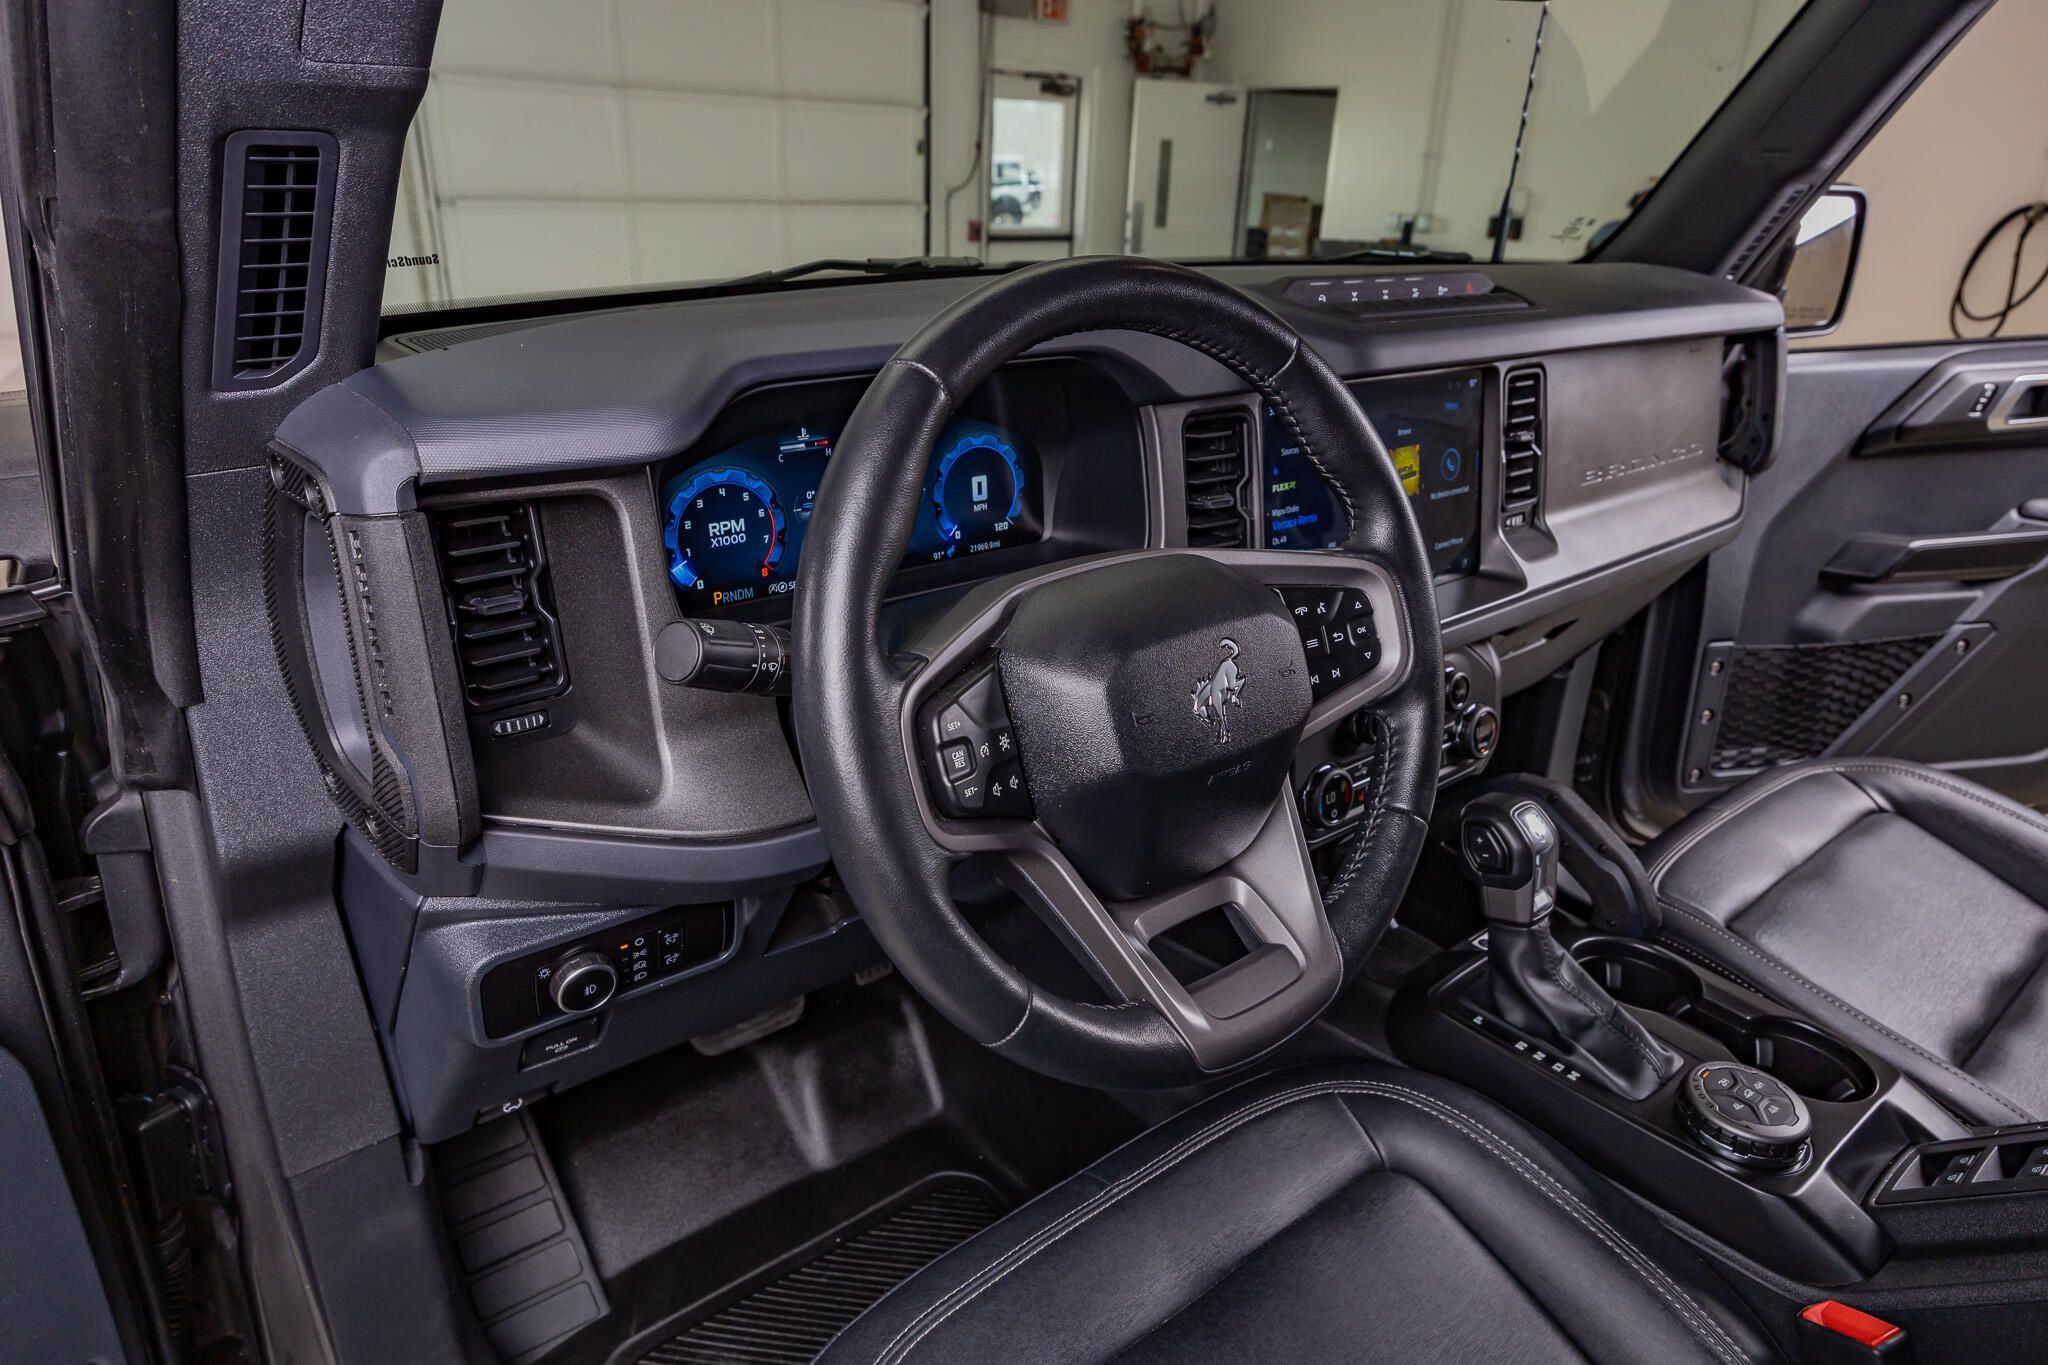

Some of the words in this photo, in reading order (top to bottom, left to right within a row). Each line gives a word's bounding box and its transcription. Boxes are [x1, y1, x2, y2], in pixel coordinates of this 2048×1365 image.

[825, 447, 832, 457] H
[1582, 443, 1703, 485] BRONCO
[719, 488, 726, 497] 4
[971, 474, 988, 502] 0
[742, 491, 750, 502] 5
[696, 499, 704, 509] 3
[973, 503, 988, 513] MPH
[758, 508, 765, 518] 6
[684, 520, 692, 530] 2
[708, 518, 746, 538] RPM
[994, 521, 1009, 532] 120
[711, 532, 747, 548] X1000
[763, 534, 770, 544] 7
[686, 548, 692, 558] 1
[761, 568, 769, 577] 8
[696, 579, 705, 590] 0
[1357, 626, 1367, 634] OK
[951, 749, 964, 760] CAN
[954, 759, 966, 769] RES
